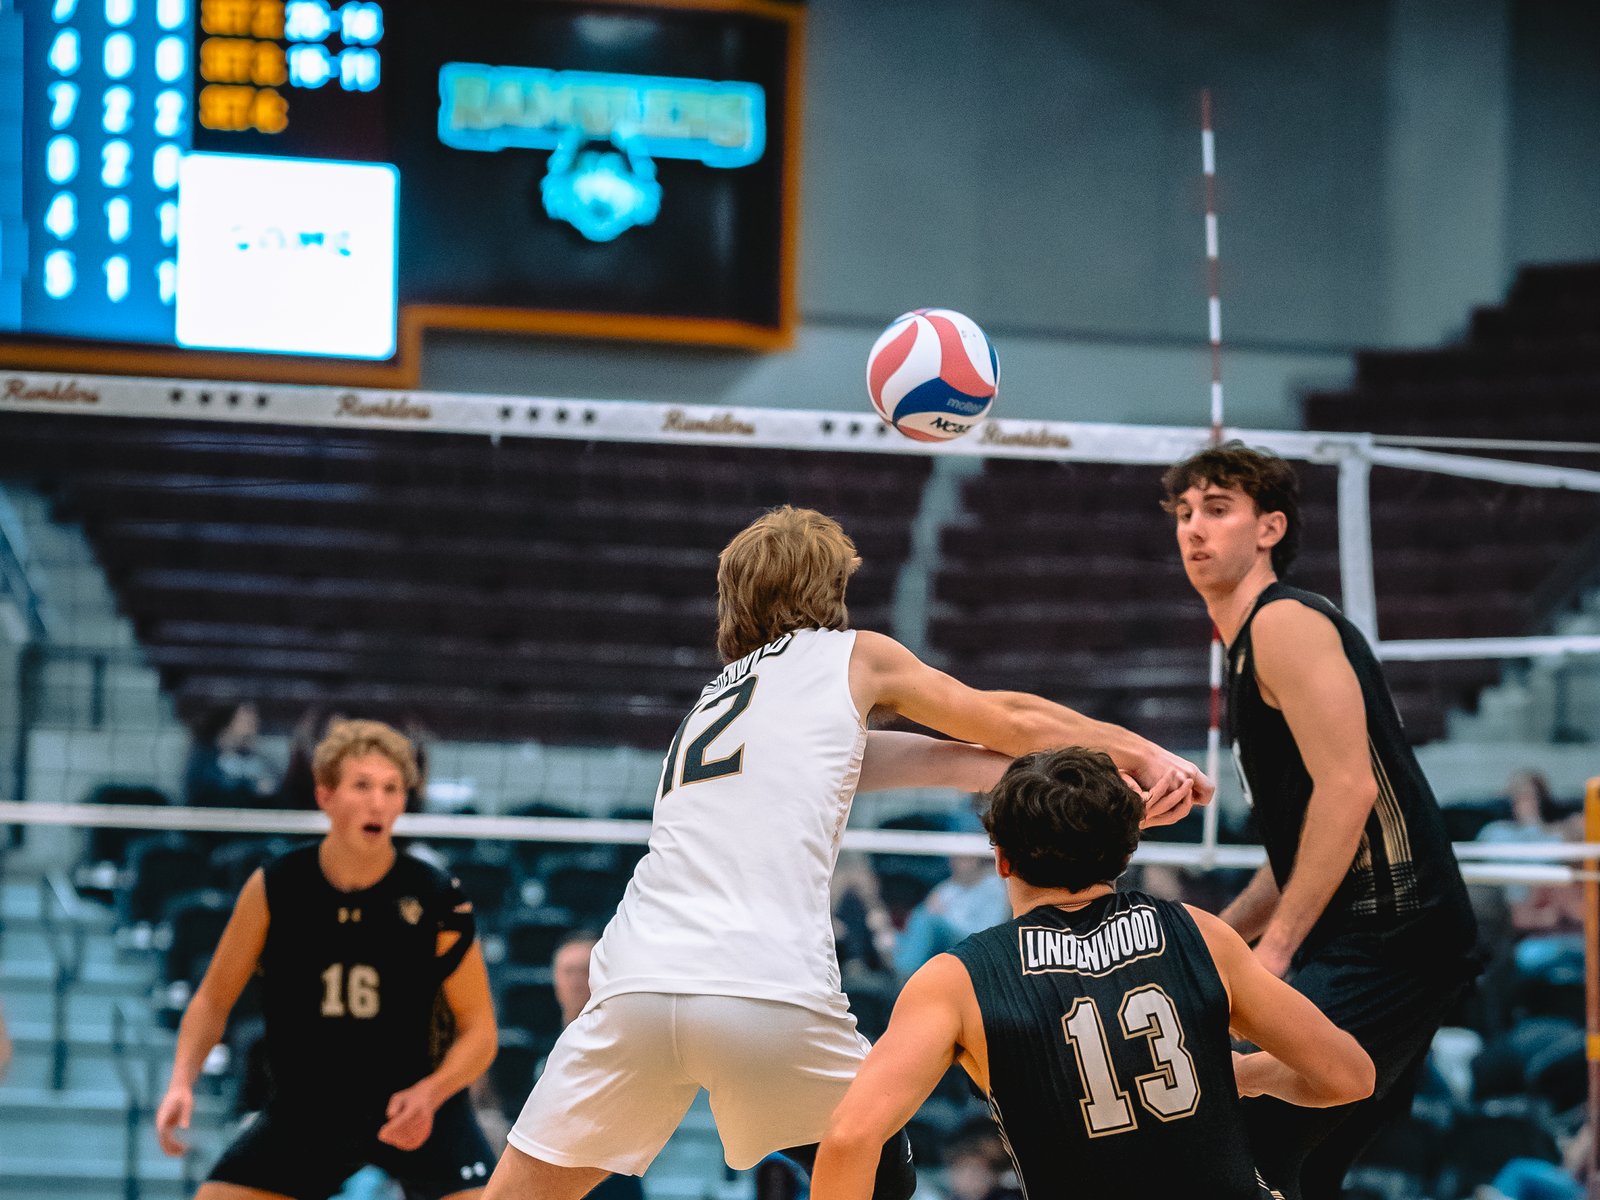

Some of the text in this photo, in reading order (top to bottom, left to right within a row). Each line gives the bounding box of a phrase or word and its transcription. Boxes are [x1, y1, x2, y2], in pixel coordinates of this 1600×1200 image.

[1026, 909, 1159, 971] LINDENWOOD
[320, 963, 380, 1019] 16
[1061, 983, 1201, 1138] 13
